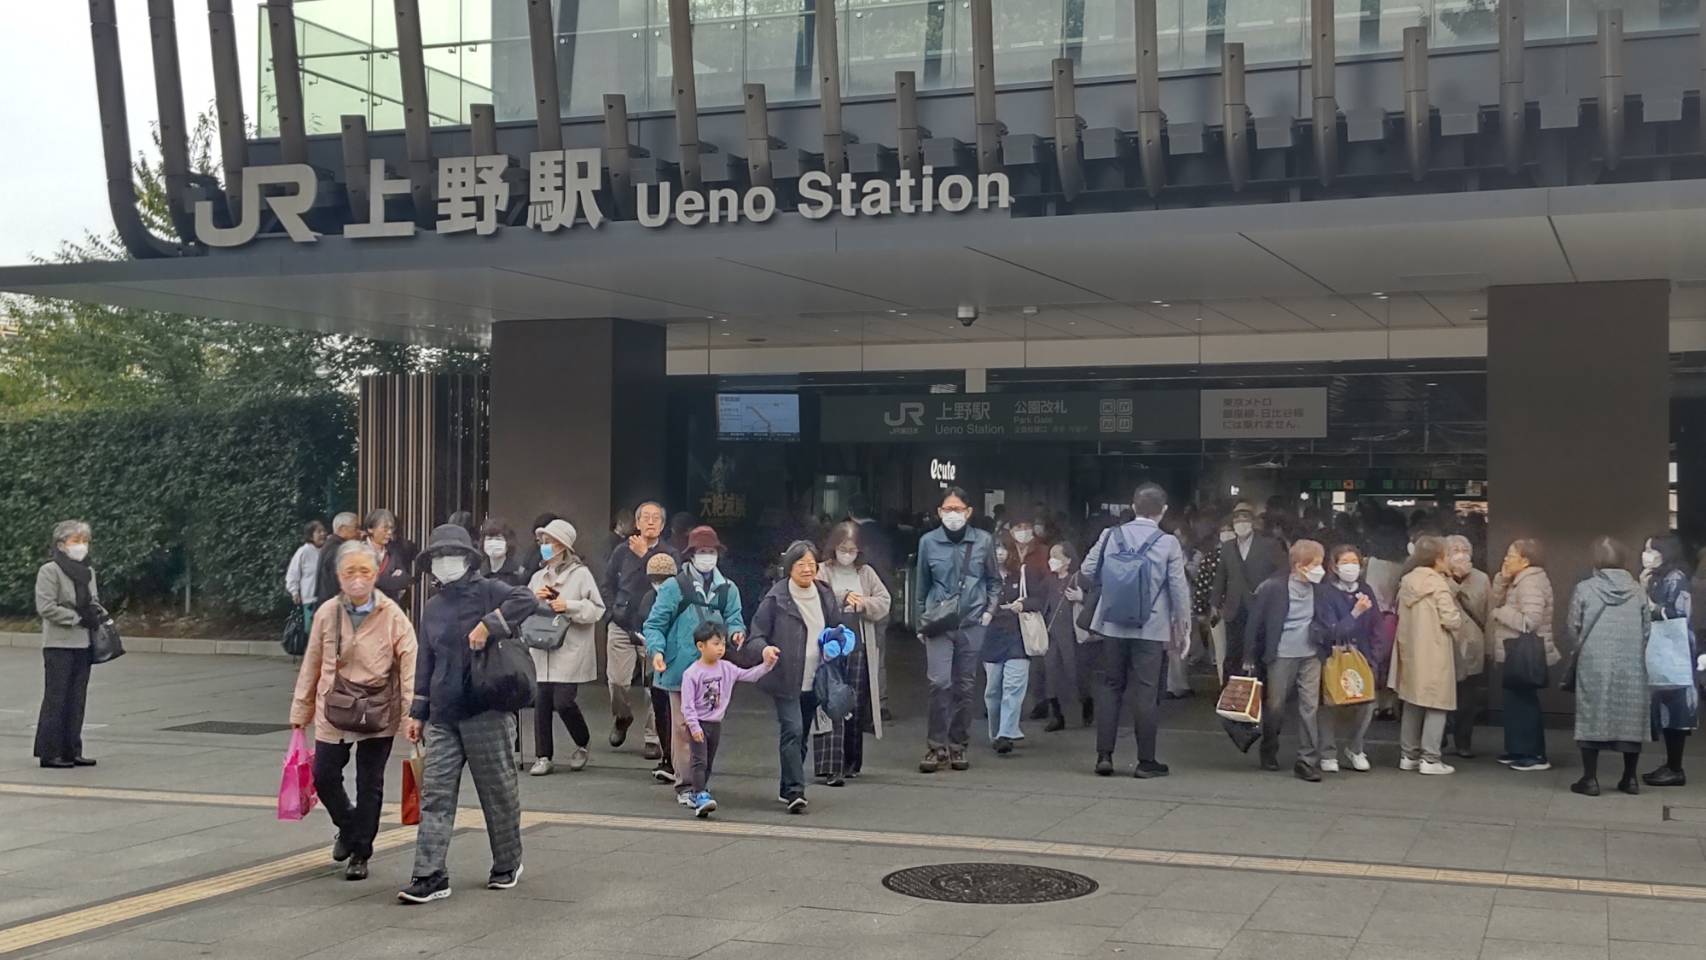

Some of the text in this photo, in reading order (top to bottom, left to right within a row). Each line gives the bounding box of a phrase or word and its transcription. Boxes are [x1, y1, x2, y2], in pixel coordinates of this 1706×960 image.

[195, 148, 1012, 247] JR 上野駅 Ueno Station
[884, 401, 991, 426] JR 上野駅
[1014, 400, 1067, 414] 公園改札
[935, 424, 963, 435] Ueno
[967, 423, 1004, 435] Station
